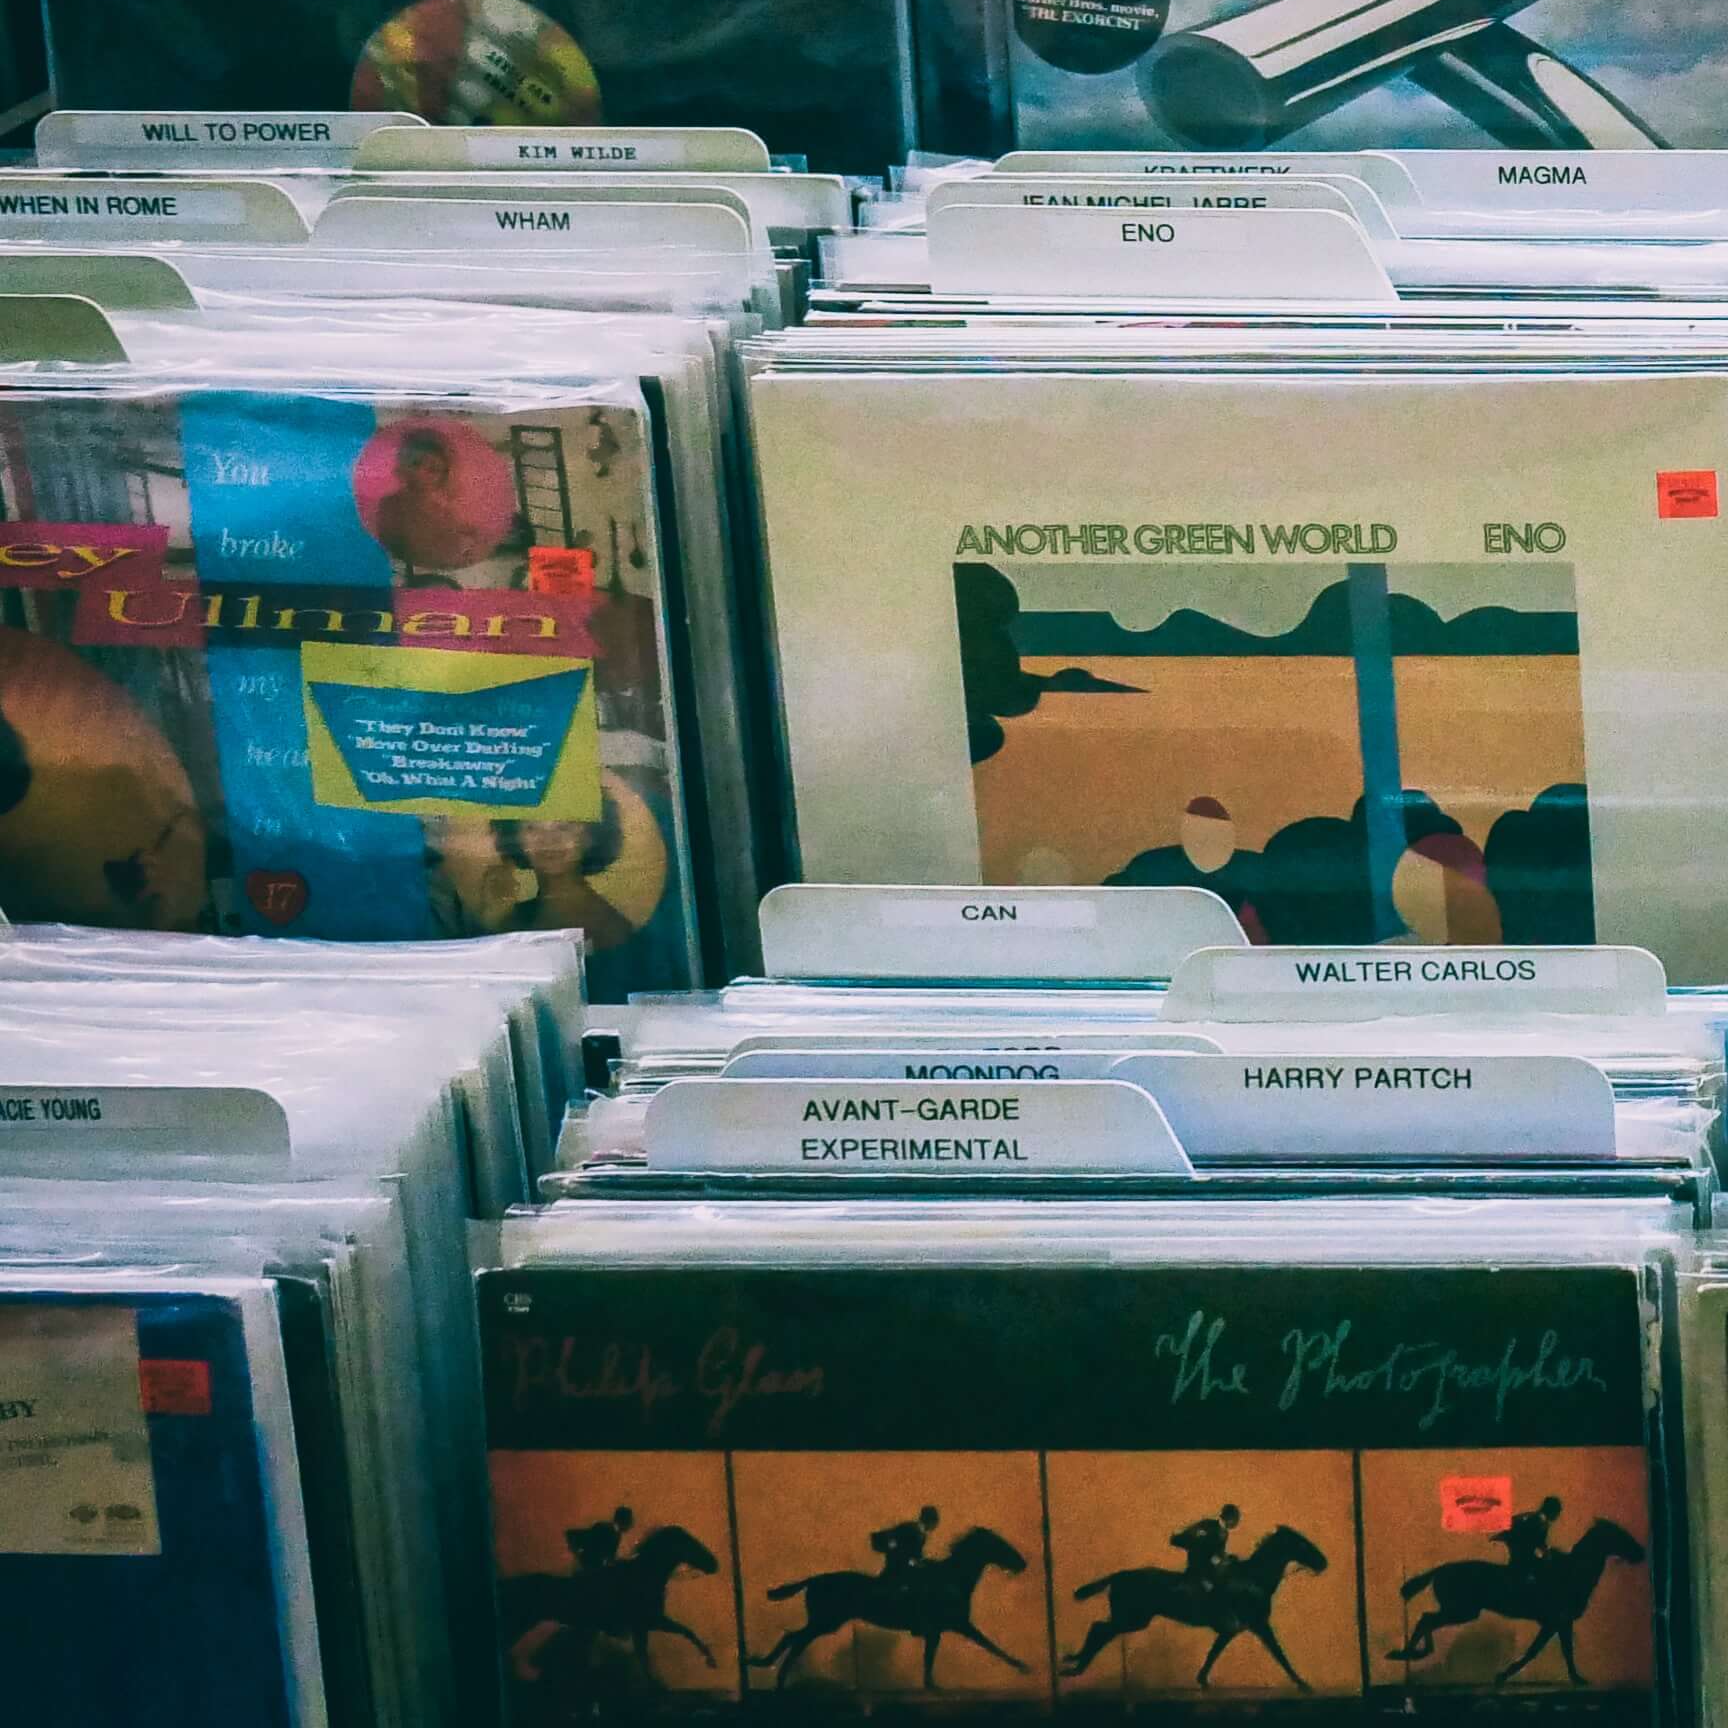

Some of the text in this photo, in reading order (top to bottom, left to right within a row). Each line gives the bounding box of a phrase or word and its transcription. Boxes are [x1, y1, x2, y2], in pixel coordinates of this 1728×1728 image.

[142, 123, 331, 143] WILL TO POWER
[518, 145, 637, 162] KIM WILDE
[1498, 165, 1587, 186] MAGMA
[0, 197, 177, 218] WHEN IN ROME
[495, 212, 571, 232] WHAM
[1121, 223, 1175, 243] ENO
[955, 522, 1567, 555] ANOTHER GREEN WORLD ENO
[103, 589, 560, 639] Ullman
[961, 904, 1018, 921] CAN
[1295, 960, 1536, 985] WALTER CARLOS
[1244, 1068, 1473, 1090] HARRY PARTCH
[802, 1098, 1020, 1124] AVANT-GARDE
[801, 1139, 1028, 1162] EXPERIMENTAL
